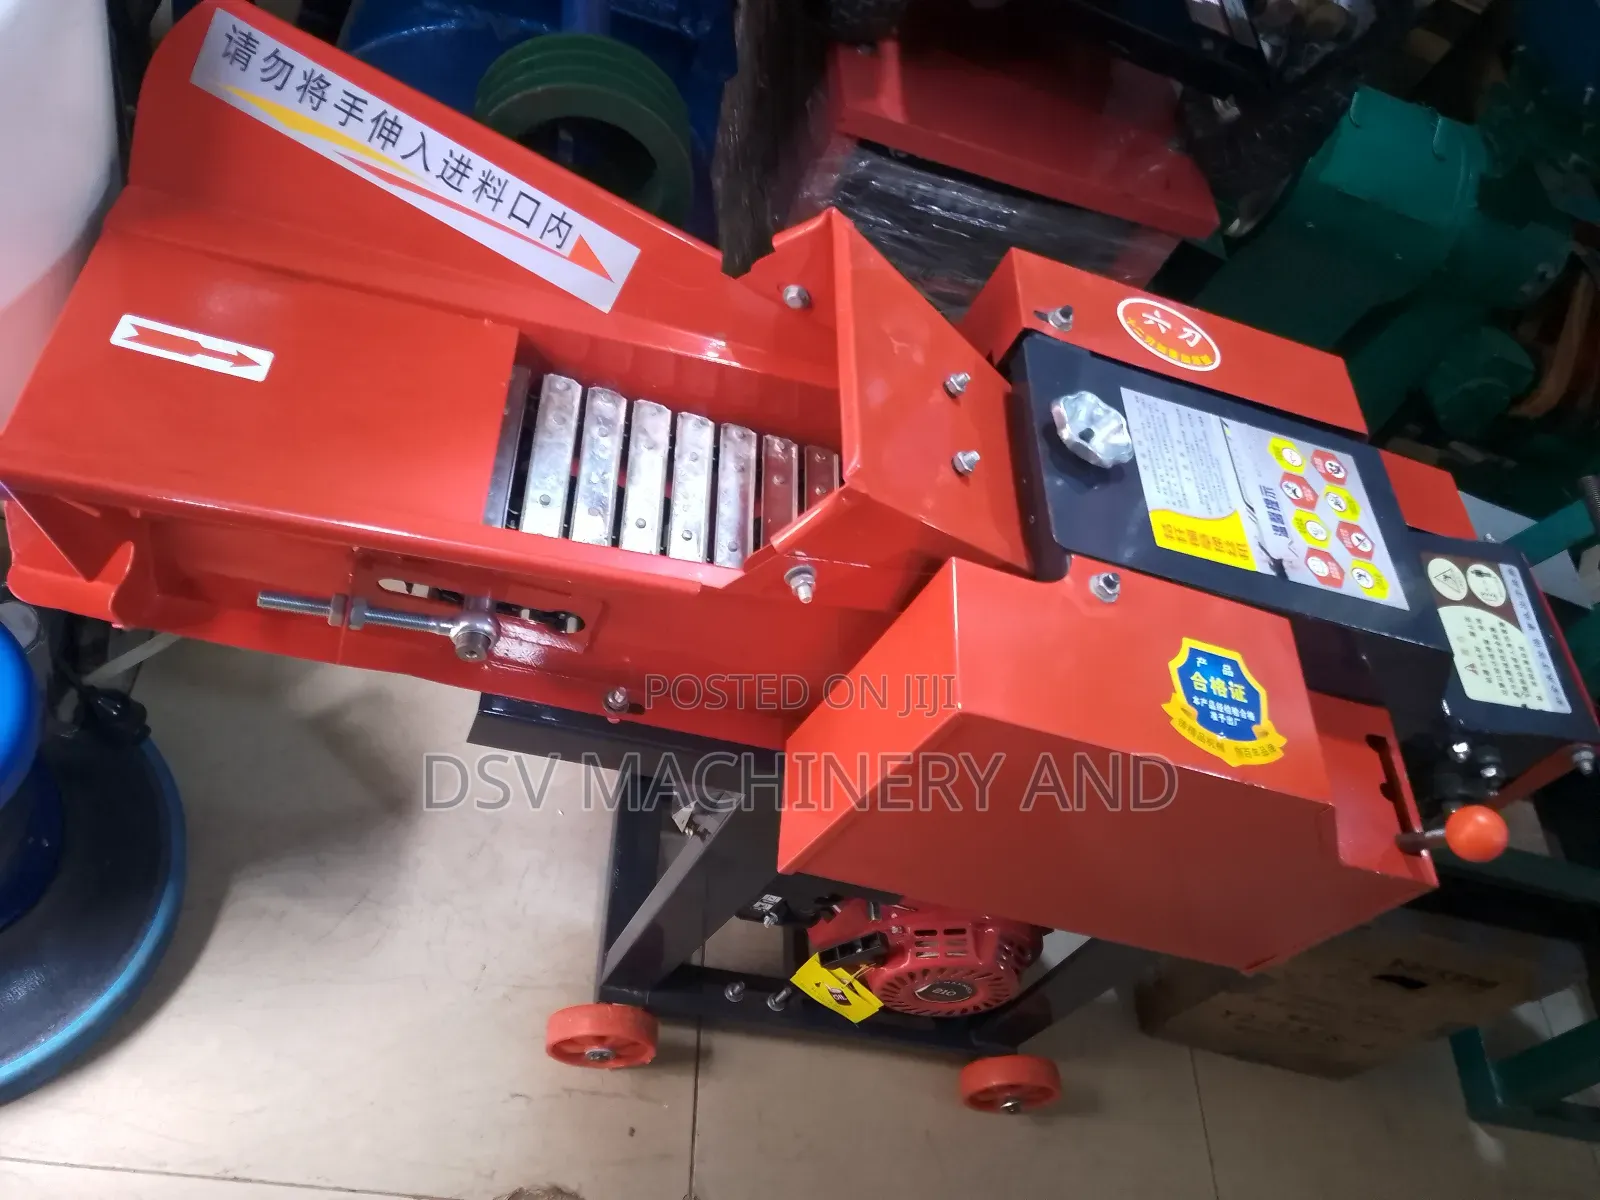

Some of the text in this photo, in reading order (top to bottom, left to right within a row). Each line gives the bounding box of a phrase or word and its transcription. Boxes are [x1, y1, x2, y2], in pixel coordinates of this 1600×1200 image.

[221, 24, 574, 249] 请勿将手伸入进料口内
[1195, 656, 1234, 677] 产品
[1190, 671, 1248, 704] 合格证
